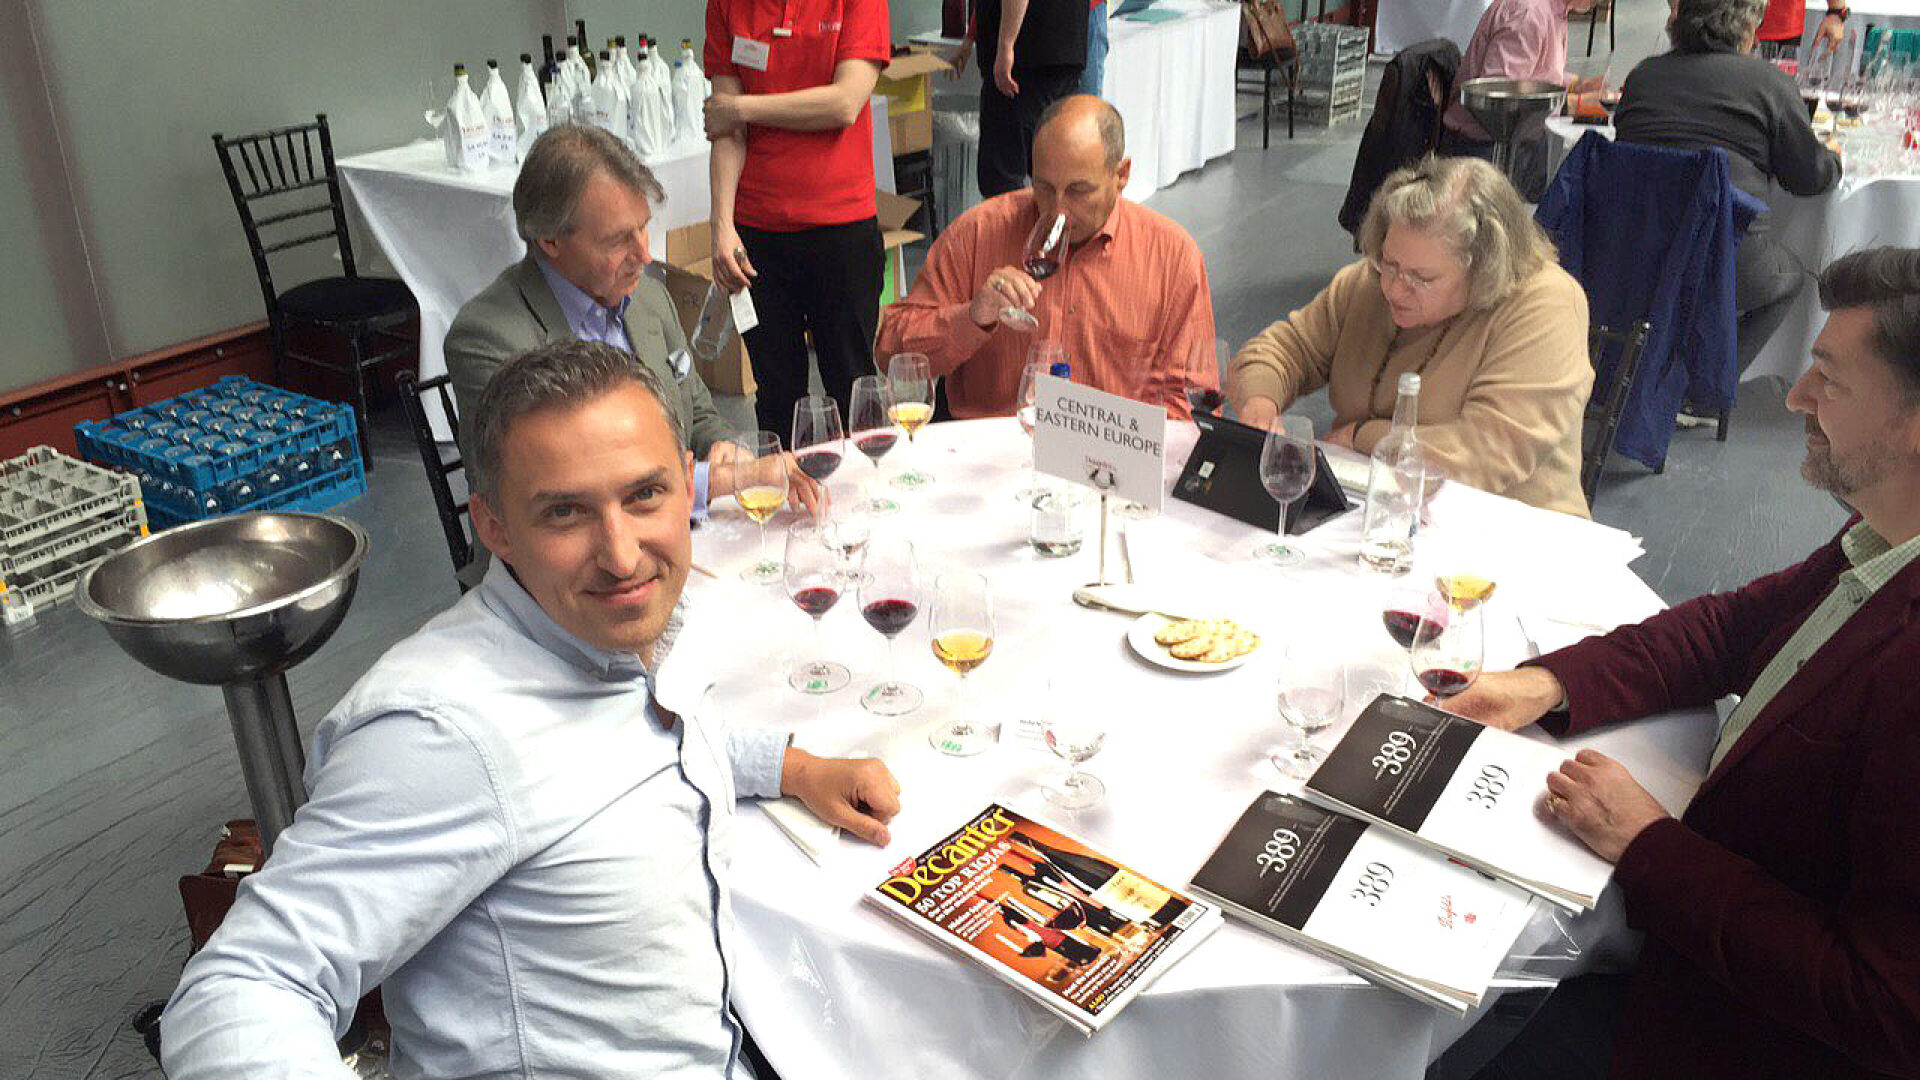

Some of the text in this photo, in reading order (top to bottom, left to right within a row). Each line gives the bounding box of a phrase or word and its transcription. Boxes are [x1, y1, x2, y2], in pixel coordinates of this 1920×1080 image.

[1036, 408, 1161, 457] EASTERN EUROPE
[1057, 397, 1139, 433] CENTRAL &
[1372, 731, 1416, 775] 389
[1466, 764, 1510, 809] 389
[879, 808, 1014, 905] Decanter
[1256, 828, 1301, 873] 389
[915, 897, 936, 913] 50
[930, 875, 963, 901] TOP
[960, 842, 1011, 879] RIOJAS
[1351, 862, 1394, 907] 389
